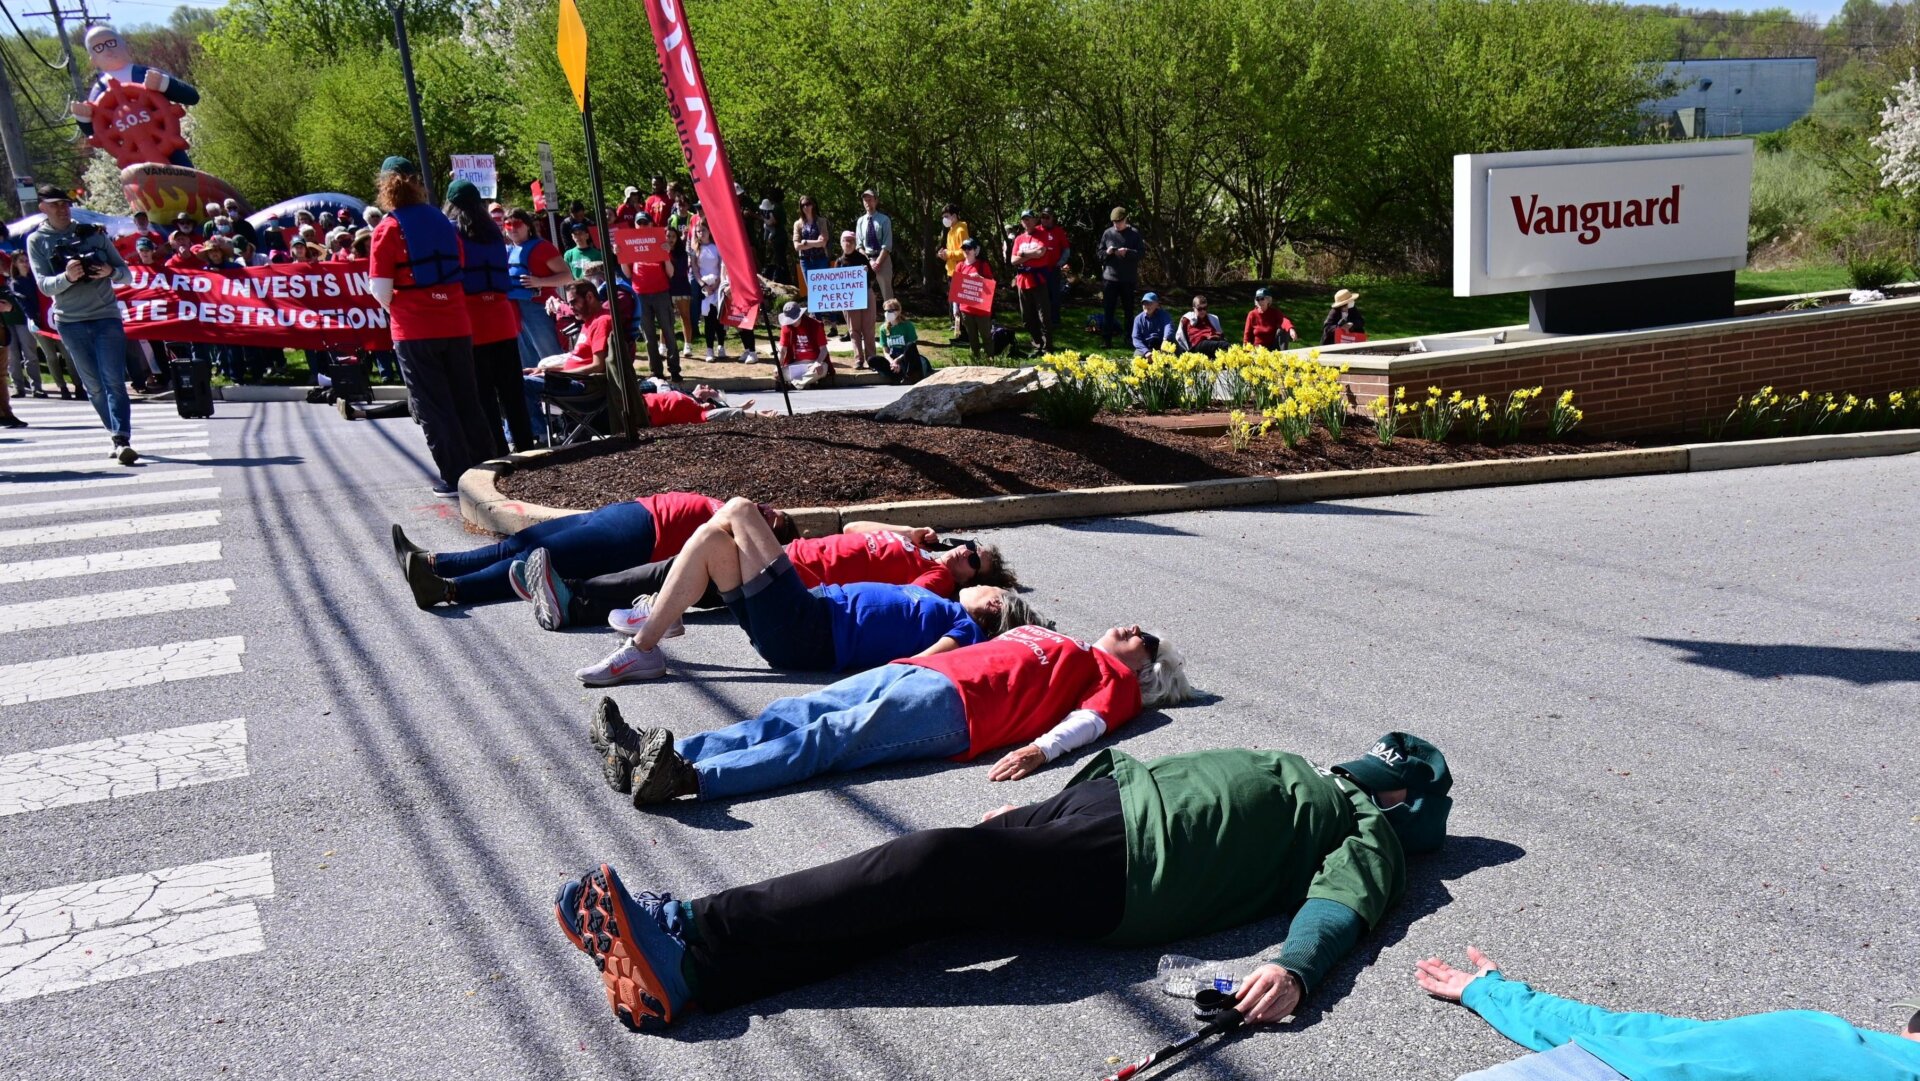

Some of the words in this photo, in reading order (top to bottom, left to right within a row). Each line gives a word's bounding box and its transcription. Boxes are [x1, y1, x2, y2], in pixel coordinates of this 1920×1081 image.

[116, 110, 151, 132] S.O.S
[143, 167, 196, 178] VANGUARD
[458, 170, 483, 182] EARTH
[1510, 184, 1681, 245] Vanguard
[625, 238, 656, 246] VANGUARD
[810, 270, 864, 281] GRANDMOTHER
[111, 271, 213, 294] UARD
[222, 274, 341, 299] INVESTS
[344, 271, 373, 296] IN
[812, 284, 828, 292] FOR
[830, 281, 864, 291] CLIMATE
[821, 292, 854, 301] MERCY
[818, 301, 854, 310] PLEASE
[178, 301, 388, 330] DESTRUCTION
